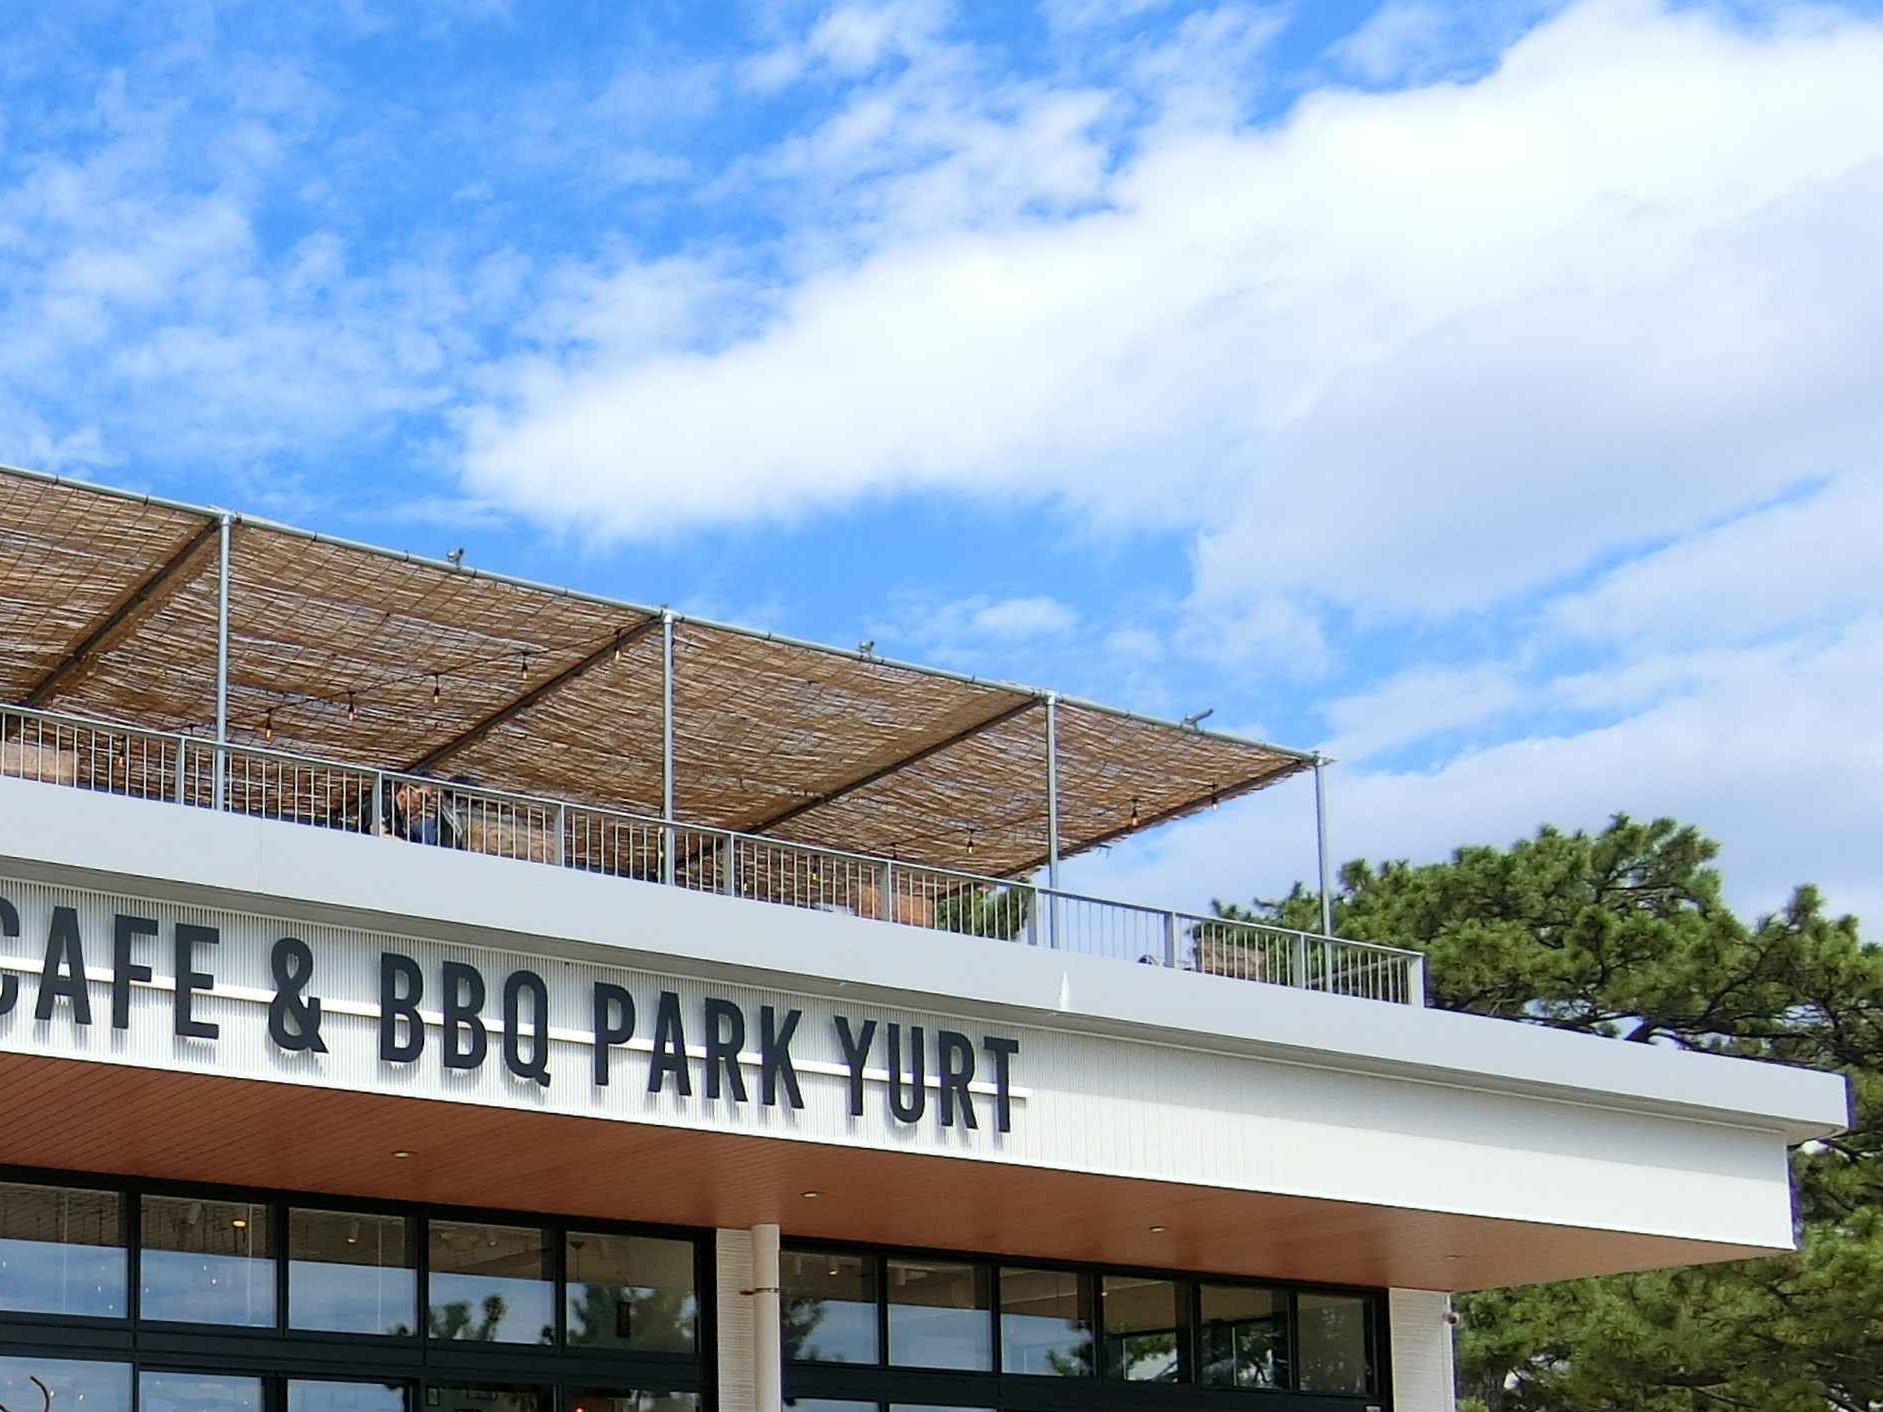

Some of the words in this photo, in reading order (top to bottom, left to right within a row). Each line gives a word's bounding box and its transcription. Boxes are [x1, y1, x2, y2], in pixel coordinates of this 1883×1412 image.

[268, 936, 329, 1054] &
[380, 951, 551, 1087] BBQ
[594, 981, 805, 1110] PARK
[834, 1014, 1020, 1133] YURT
